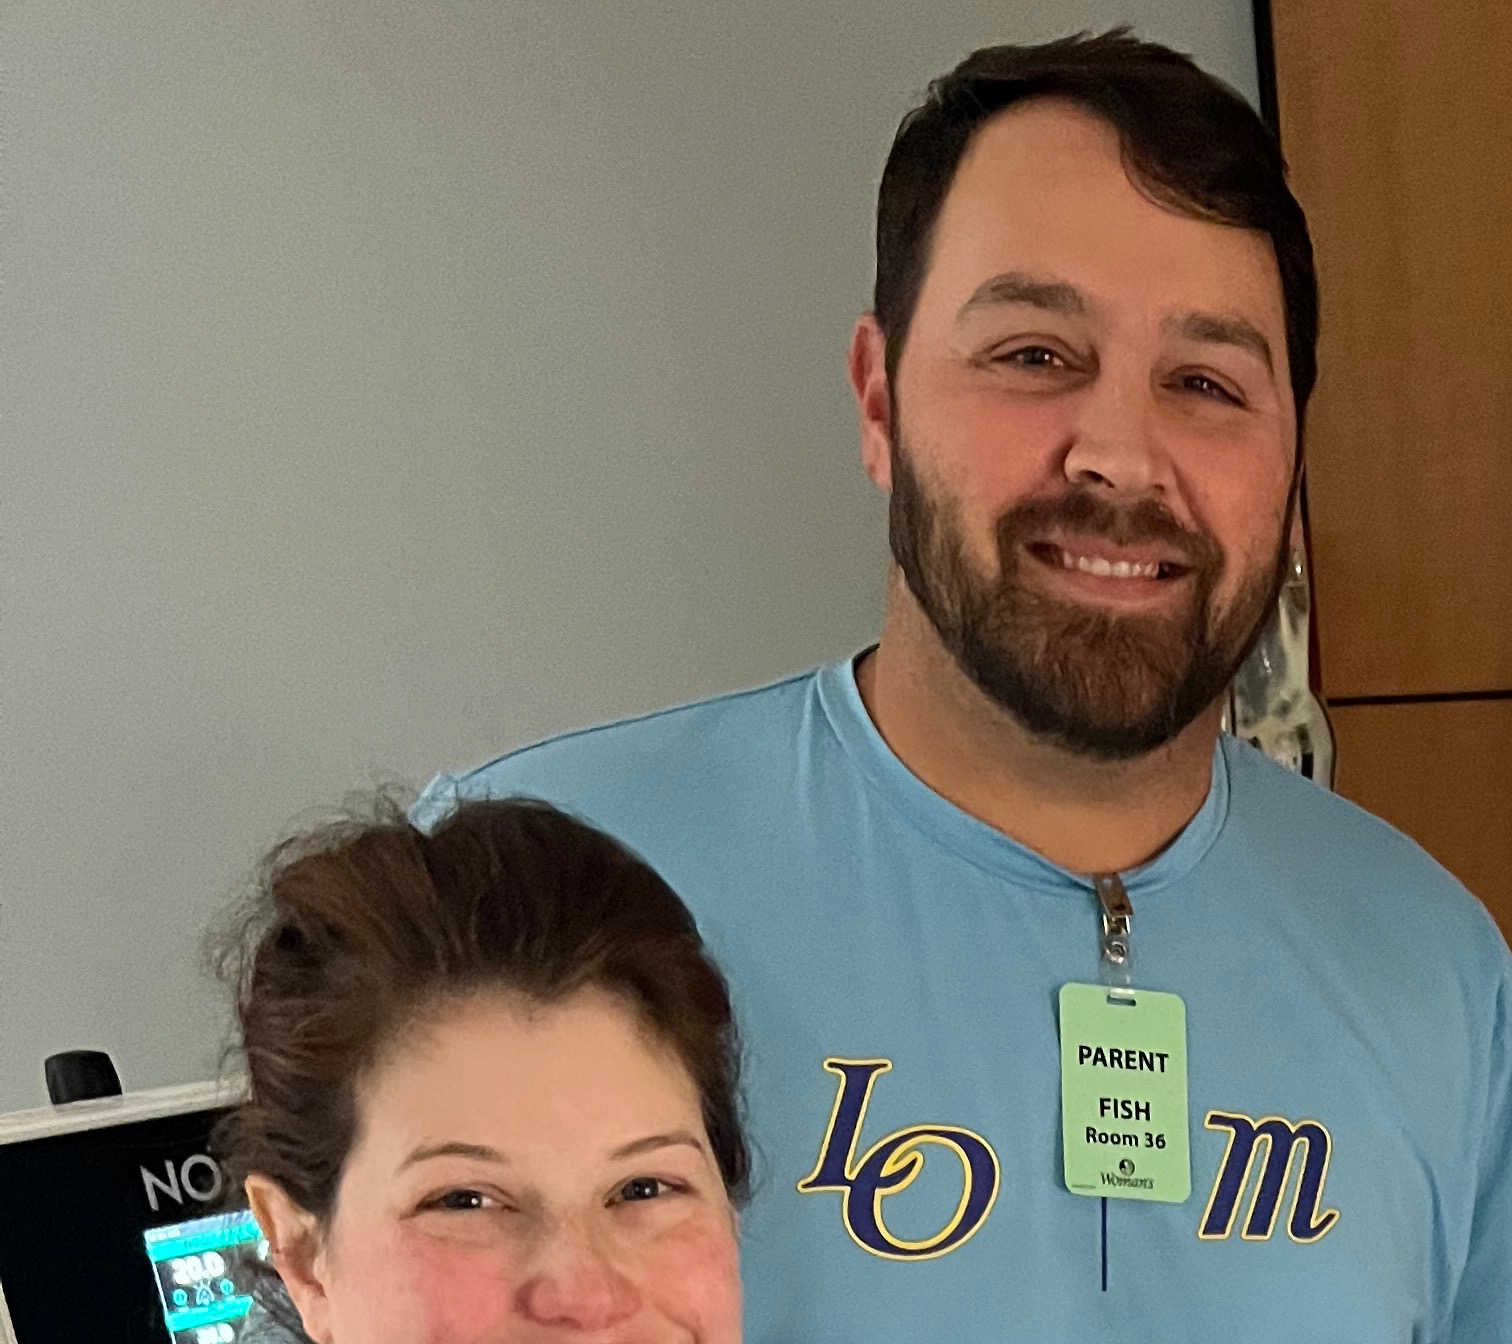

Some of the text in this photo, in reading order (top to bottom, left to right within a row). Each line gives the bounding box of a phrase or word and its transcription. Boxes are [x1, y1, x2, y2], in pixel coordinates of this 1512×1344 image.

[1078, 1045, 1169, 1073] PARENT
[1099, 1097, 1151, 1122] FISH
[1086, 1126, 1167, 1149] Room 36
